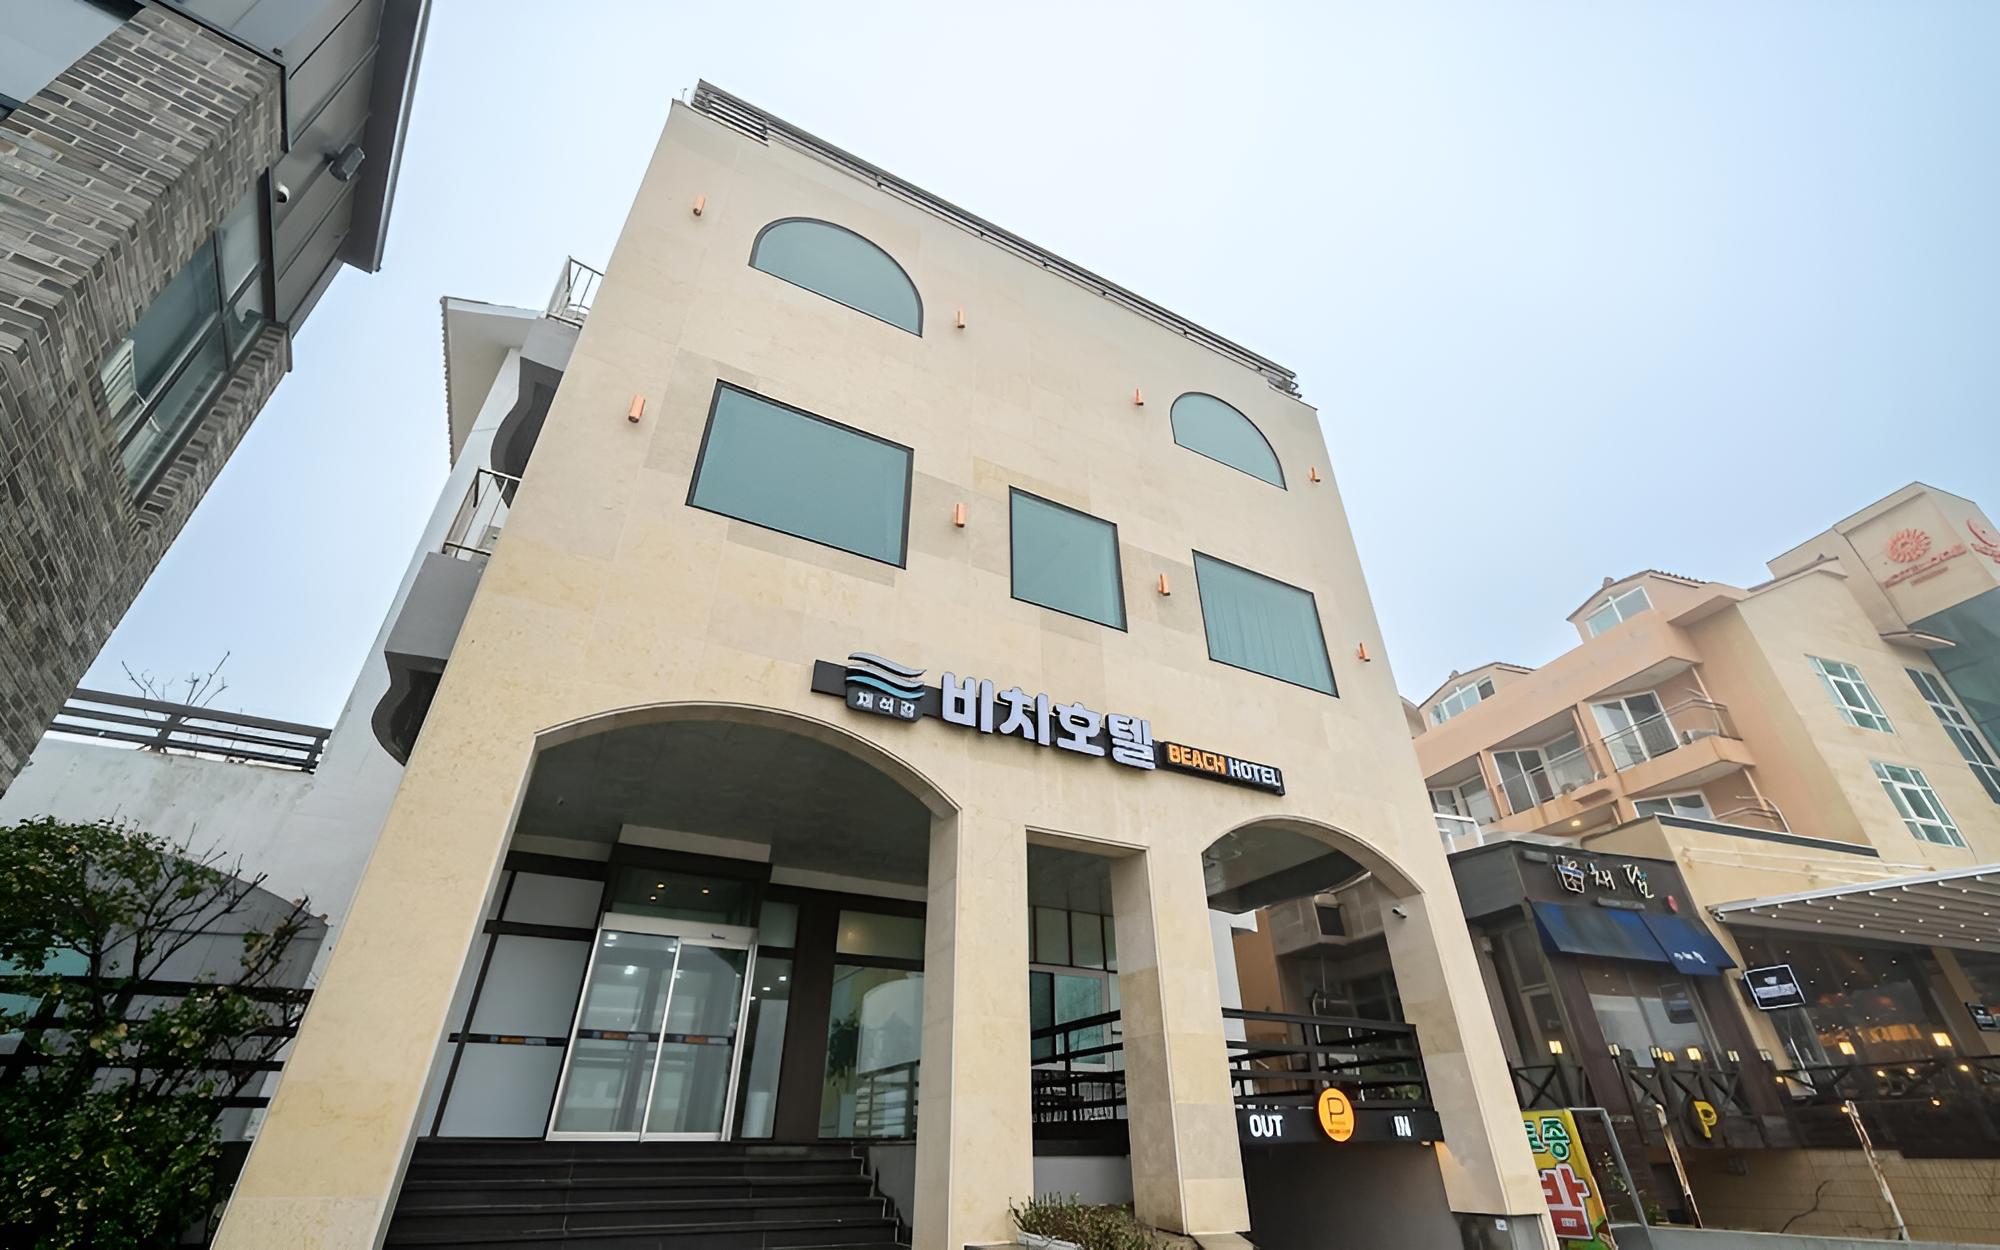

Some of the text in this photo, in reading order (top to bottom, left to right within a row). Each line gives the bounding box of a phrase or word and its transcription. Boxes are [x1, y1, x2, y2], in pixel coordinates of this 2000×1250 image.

[942, 671, 1156, 770] 비치호텔
[1167, 743, 1281, 787] BEACH HOTEL
[1249, 1114, 1283, 1138] OUT
[1326, 1096, 1345, 1126] P
[1393, 1115, 1412, 1137] IN
[1693, 1100, 1718, 1138] P
